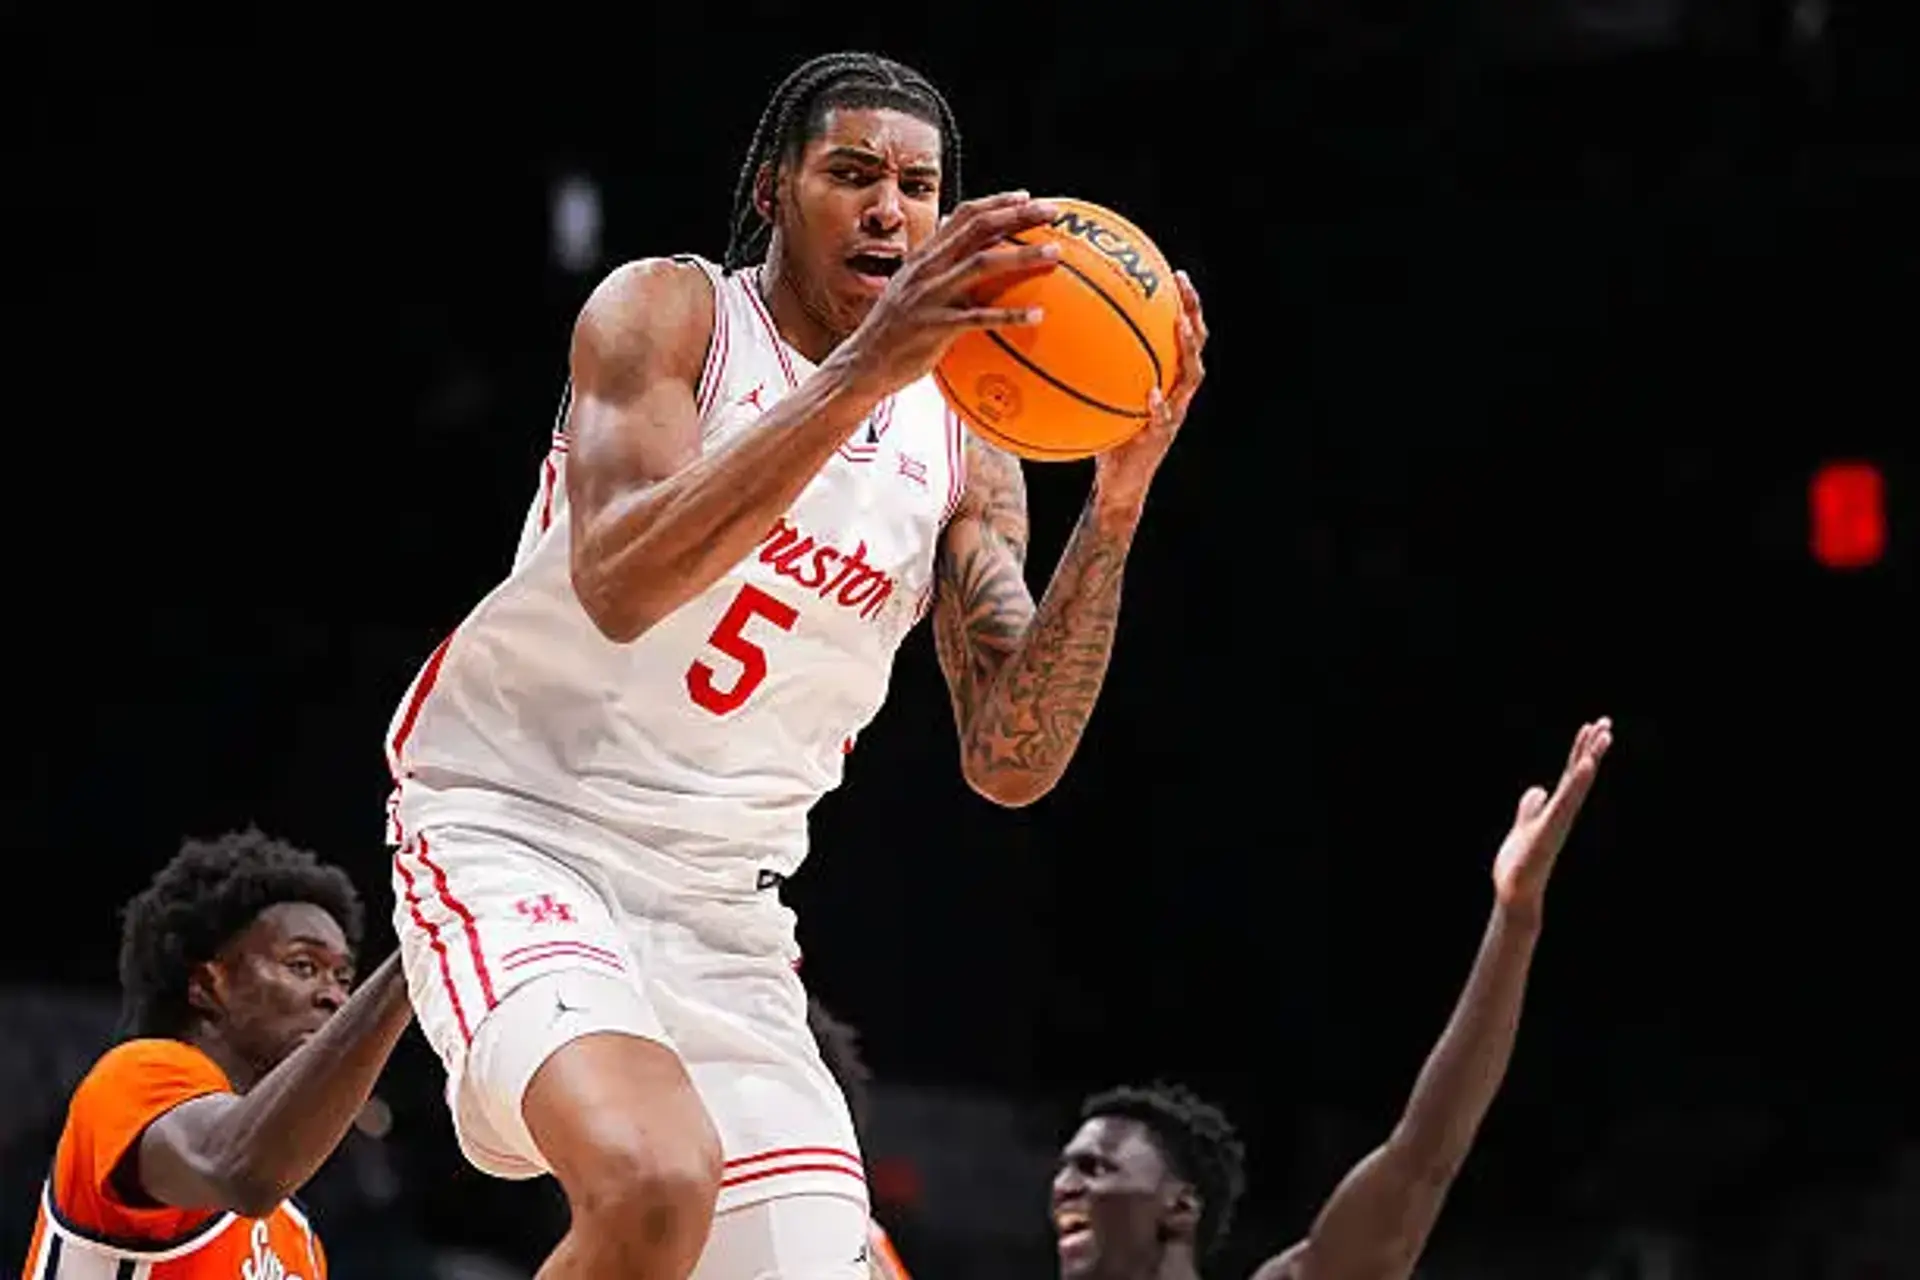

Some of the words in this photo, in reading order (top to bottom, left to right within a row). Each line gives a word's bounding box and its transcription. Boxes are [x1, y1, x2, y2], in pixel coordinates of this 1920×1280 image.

[1050, 212, 1159, 299] NCAA
[759, 516, 893, 620] uston
[684, 582, 800, 717] 5
